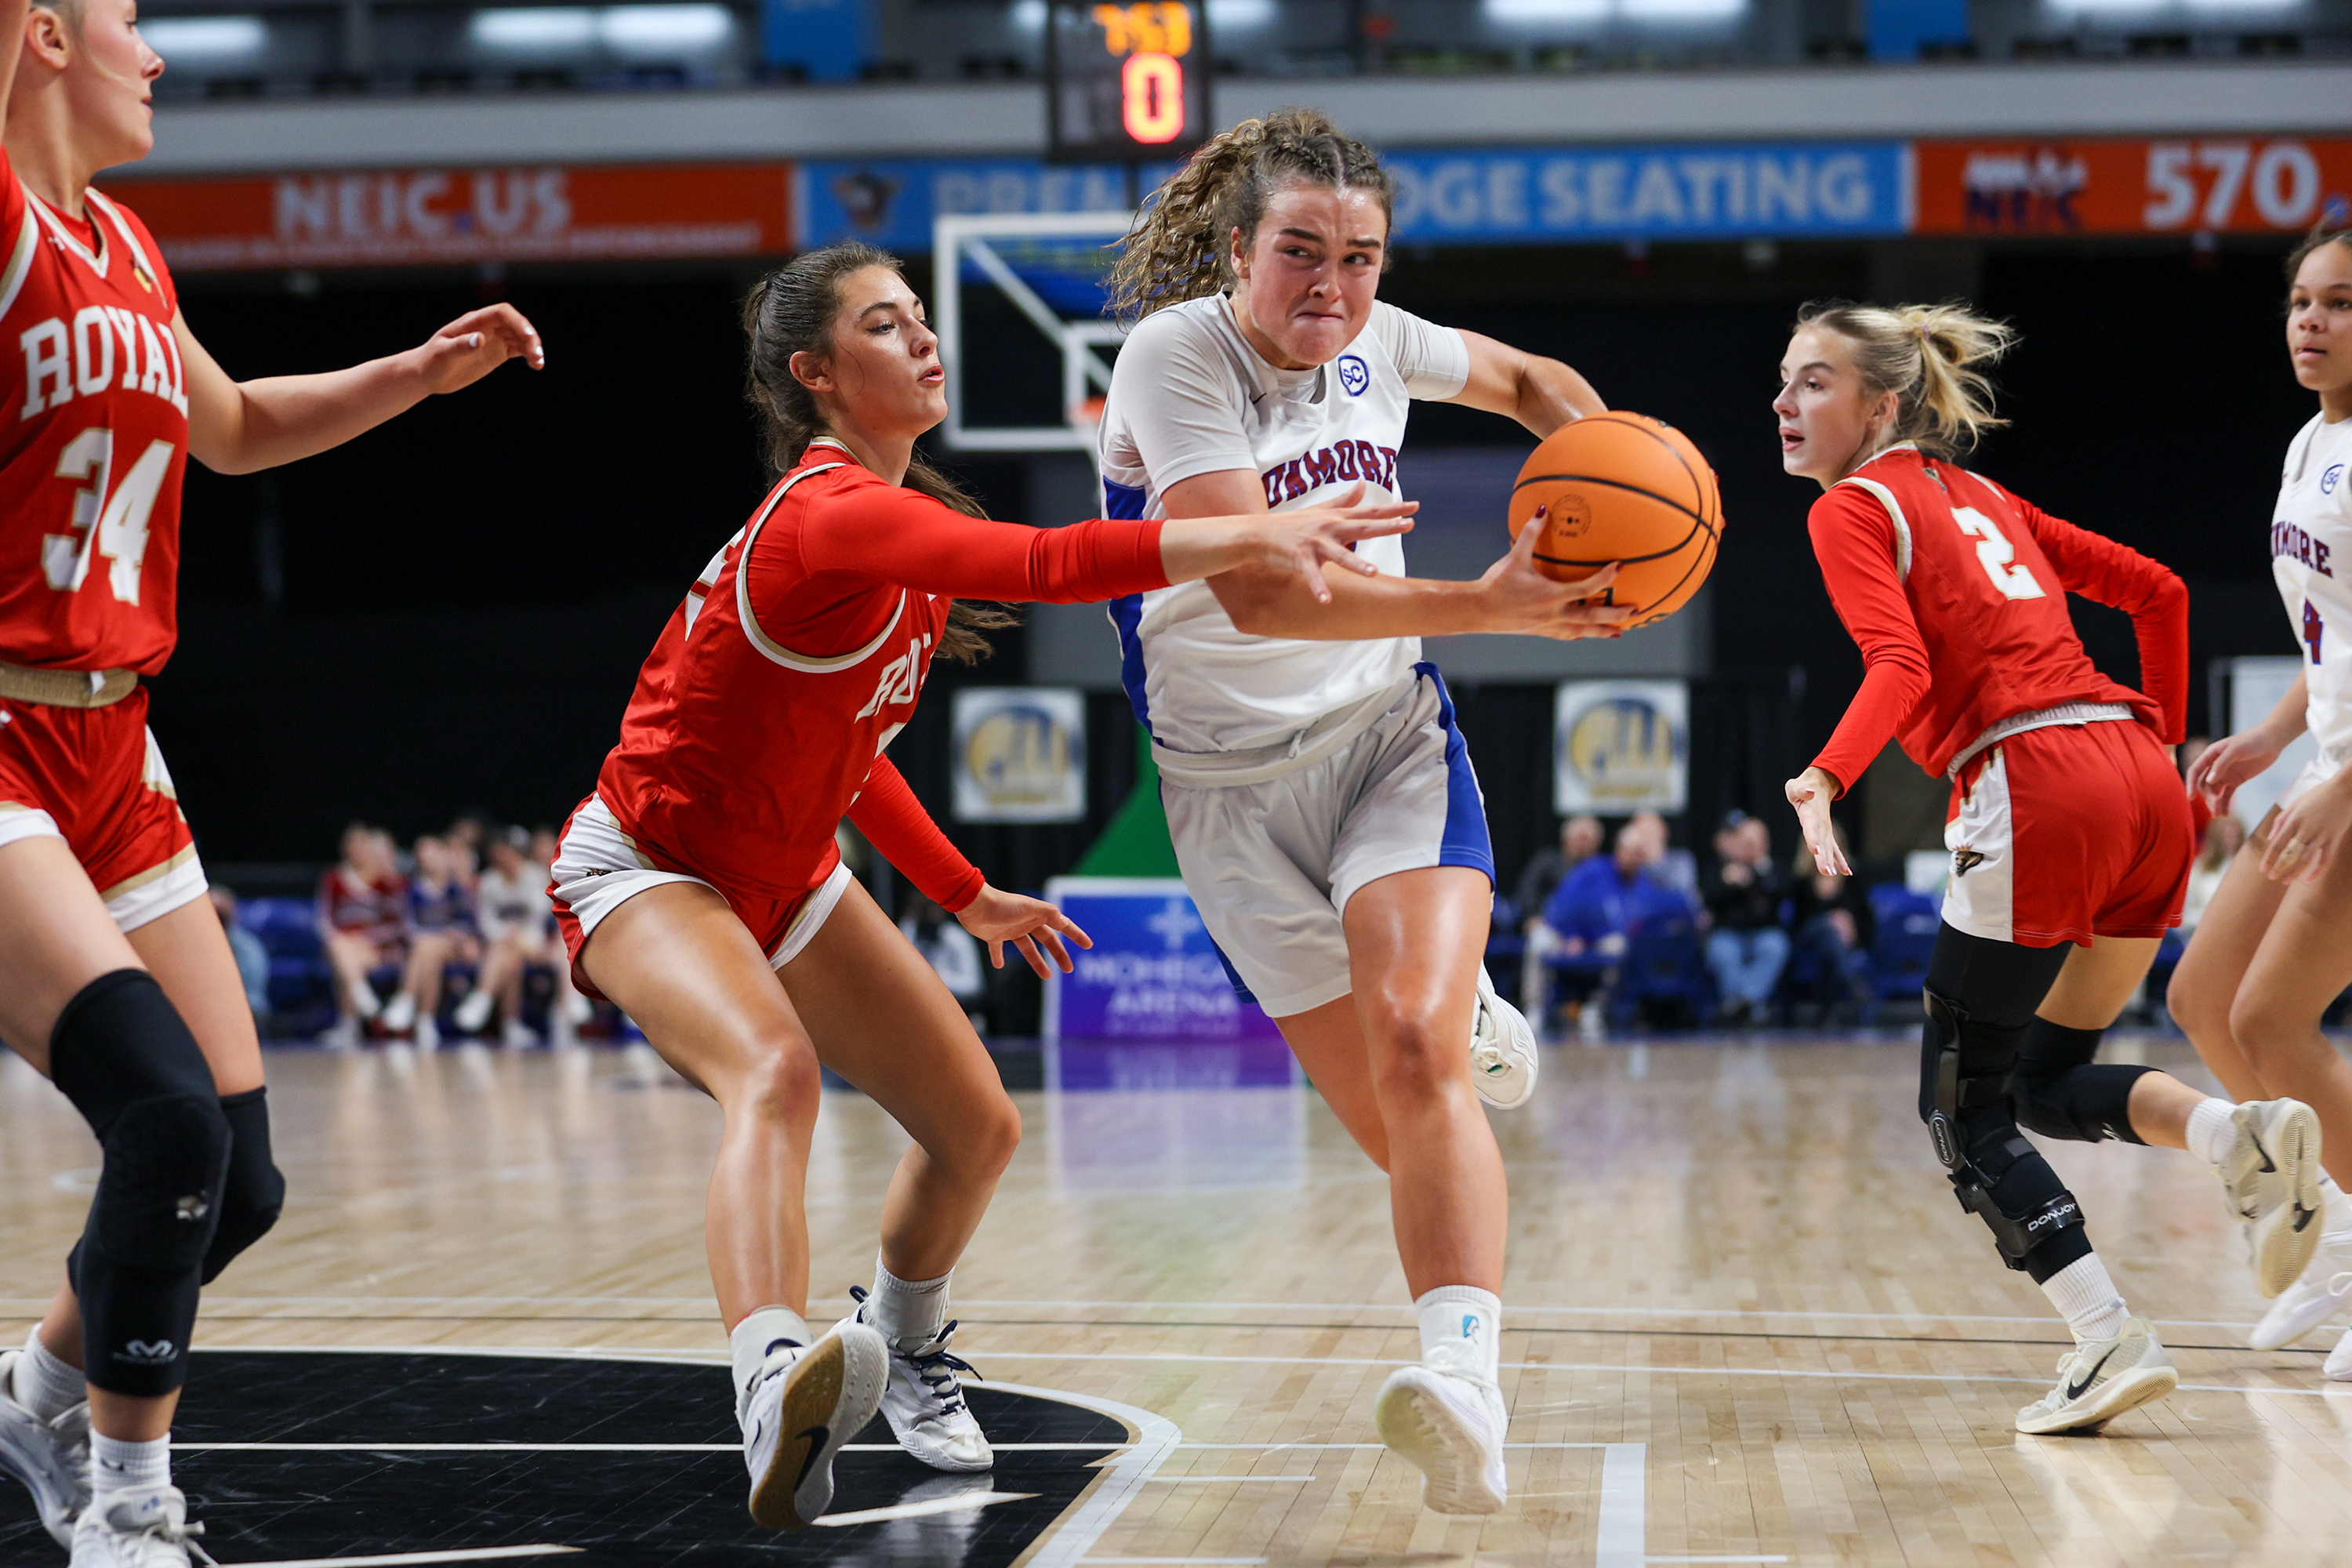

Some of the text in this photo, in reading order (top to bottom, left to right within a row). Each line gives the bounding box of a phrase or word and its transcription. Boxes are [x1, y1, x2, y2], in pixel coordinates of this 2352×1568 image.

[1123, 52, 1183, 143] 0
[271, 170, 575, 238] NEIC.US
[1538, 155, 1872, 226] SEATING
[2142, 141, 2322, 230] 570
[1343, 365, 1363, 386] SC
[1261, 438, 1397, 510] UNMORE
[41, 426, 176, 607] 34
[1950, 506, 2047, 601] 2
[2027, 1202, 2077, 1232] DONJOY
